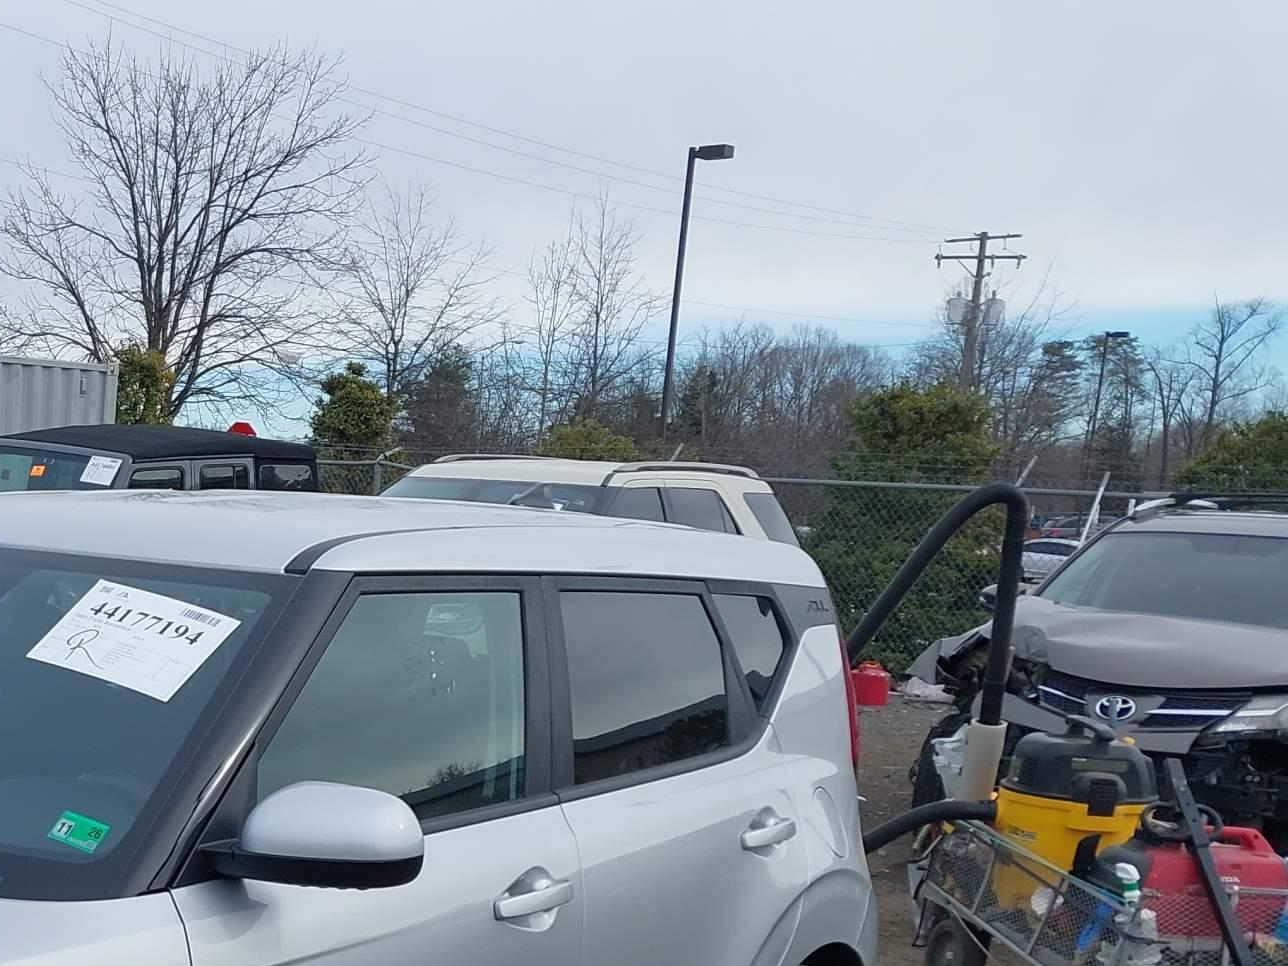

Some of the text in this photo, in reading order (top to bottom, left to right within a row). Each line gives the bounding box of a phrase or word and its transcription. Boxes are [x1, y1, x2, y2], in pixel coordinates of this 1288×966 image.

[90, 601, 206, 646] 44177194
[57, 822, 104, 840] 11 26
